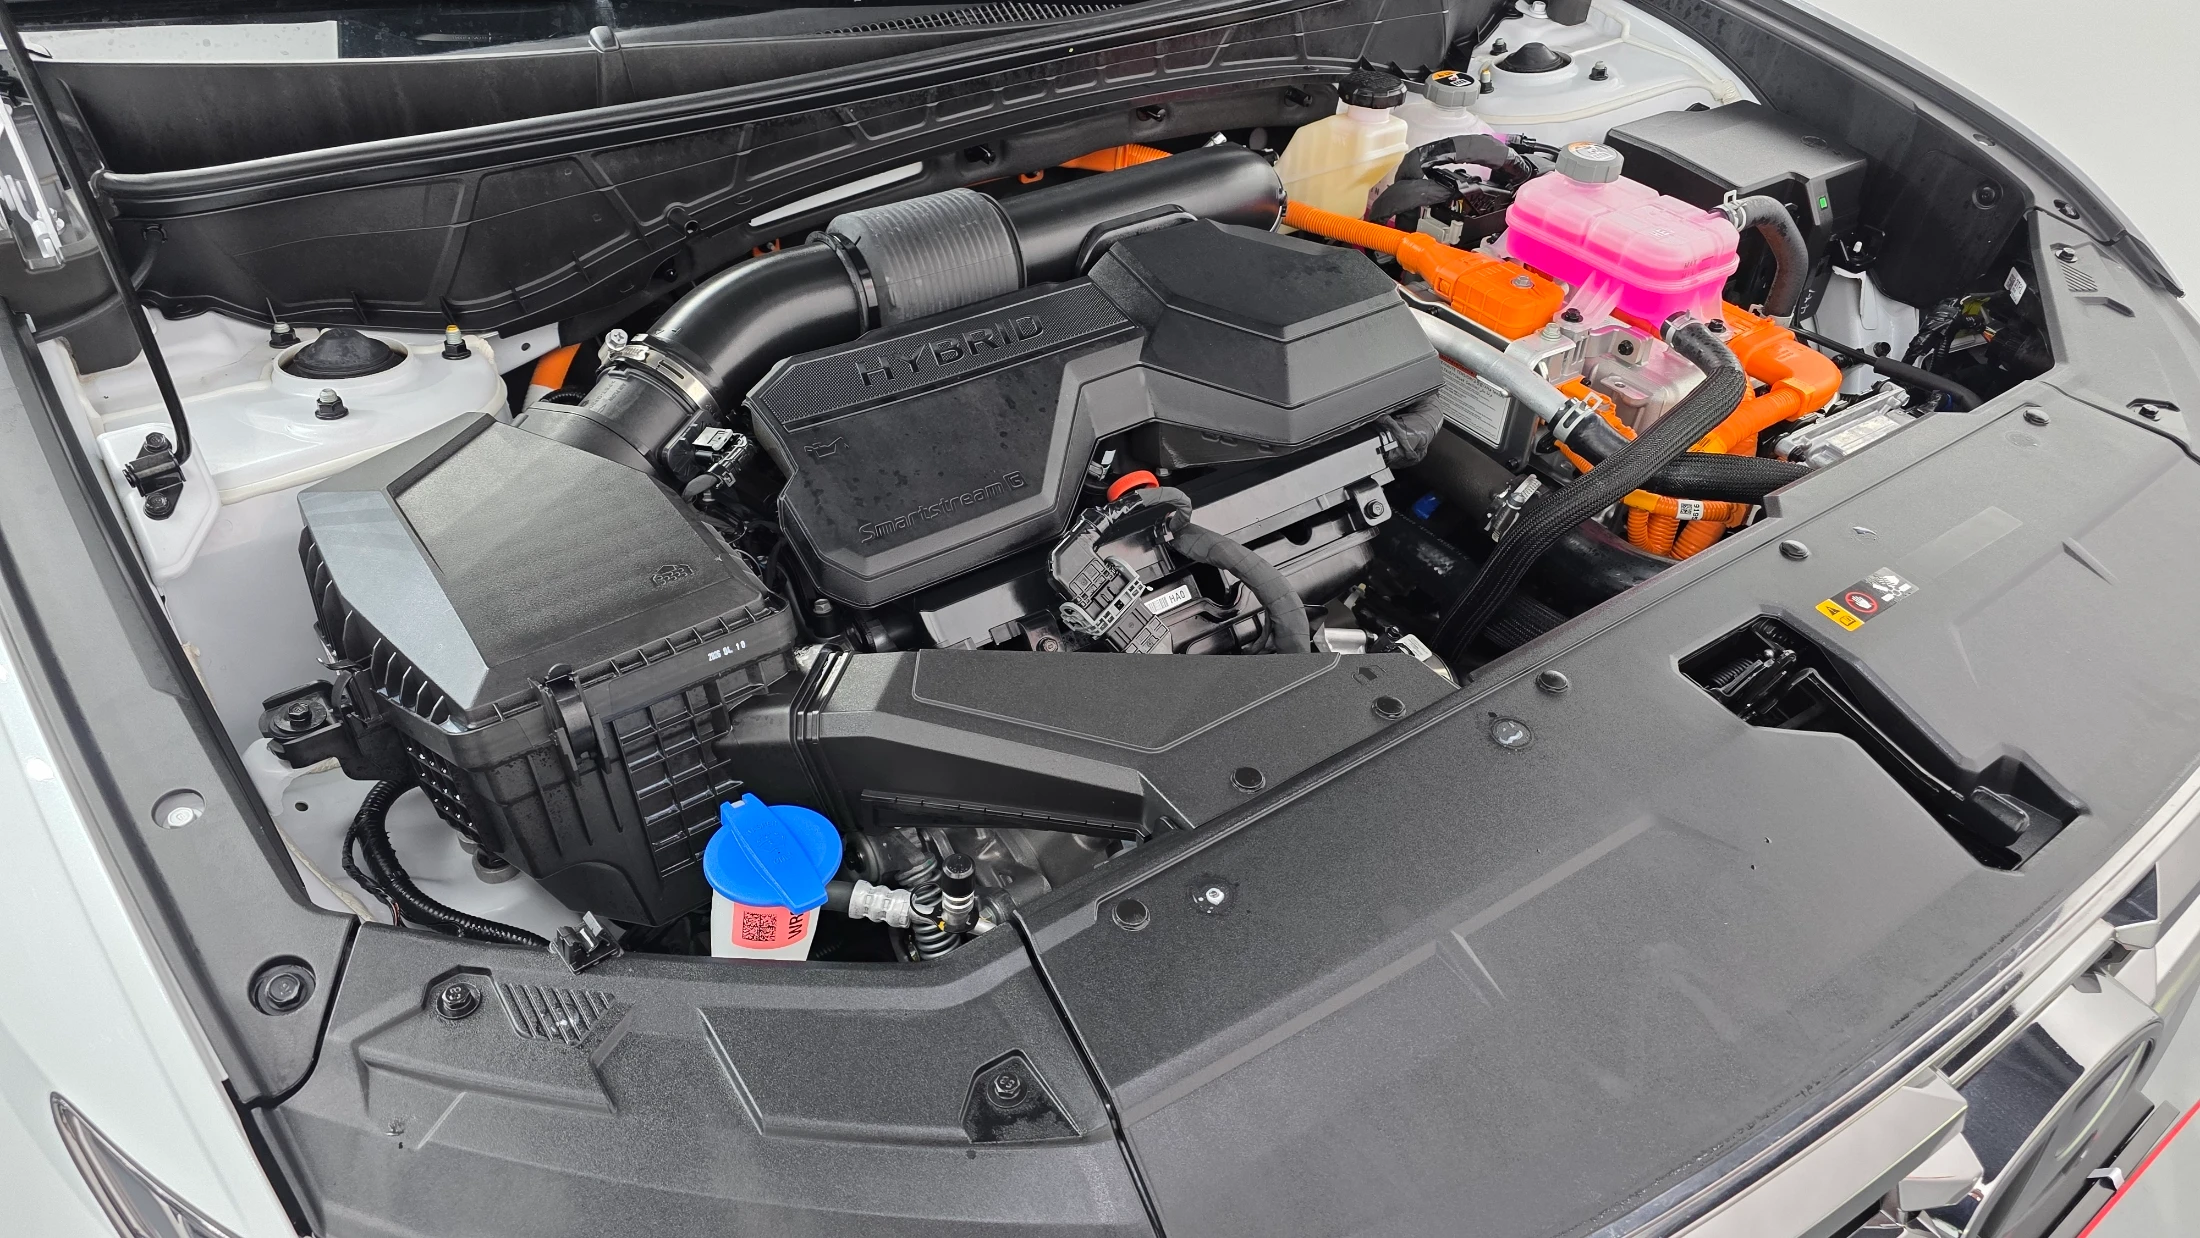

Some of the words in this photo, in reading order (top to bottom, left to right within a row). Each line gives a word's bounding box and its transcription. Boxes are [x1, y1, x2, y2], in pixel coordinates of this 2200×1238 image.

[855, 313, 1044, 387] HYBRID
[858, 481, 1003, 544] Smartstream
[1003, 470, 1026, 490] G
